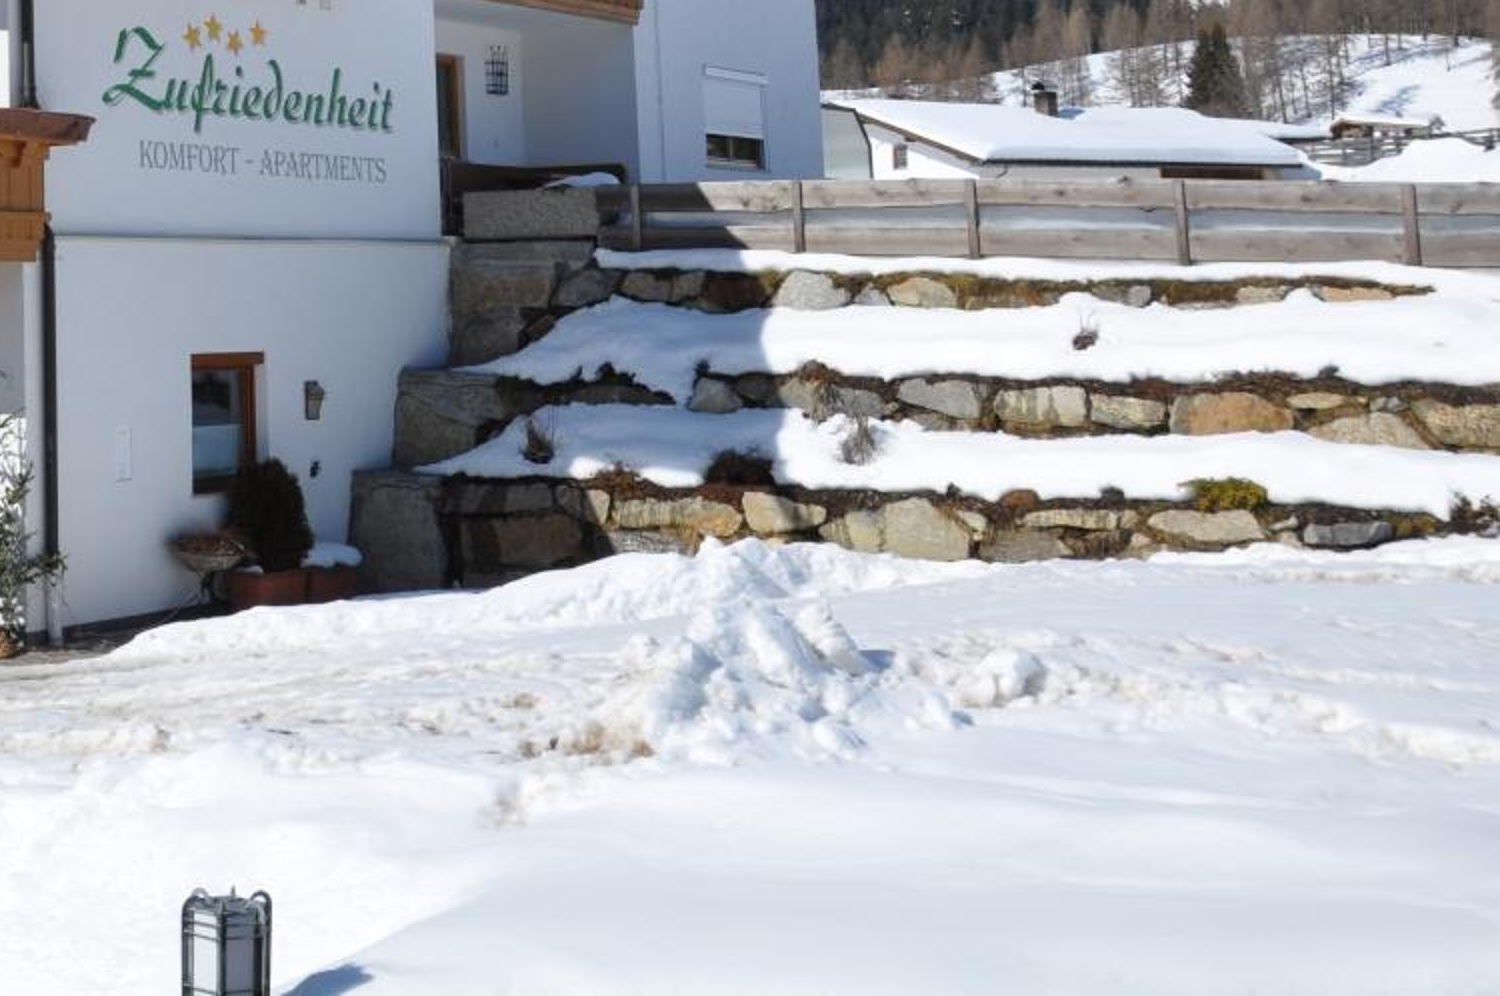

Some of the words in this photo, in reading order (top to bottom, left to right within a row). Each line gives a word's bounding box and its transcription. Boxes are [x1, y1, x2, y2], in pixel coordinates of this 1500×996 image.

[102, 26, 394, 133] Zufriedenheit
[139, 140, 240, 175] KOMFORT
[259, 149, 388, 184] APARTMENTS
